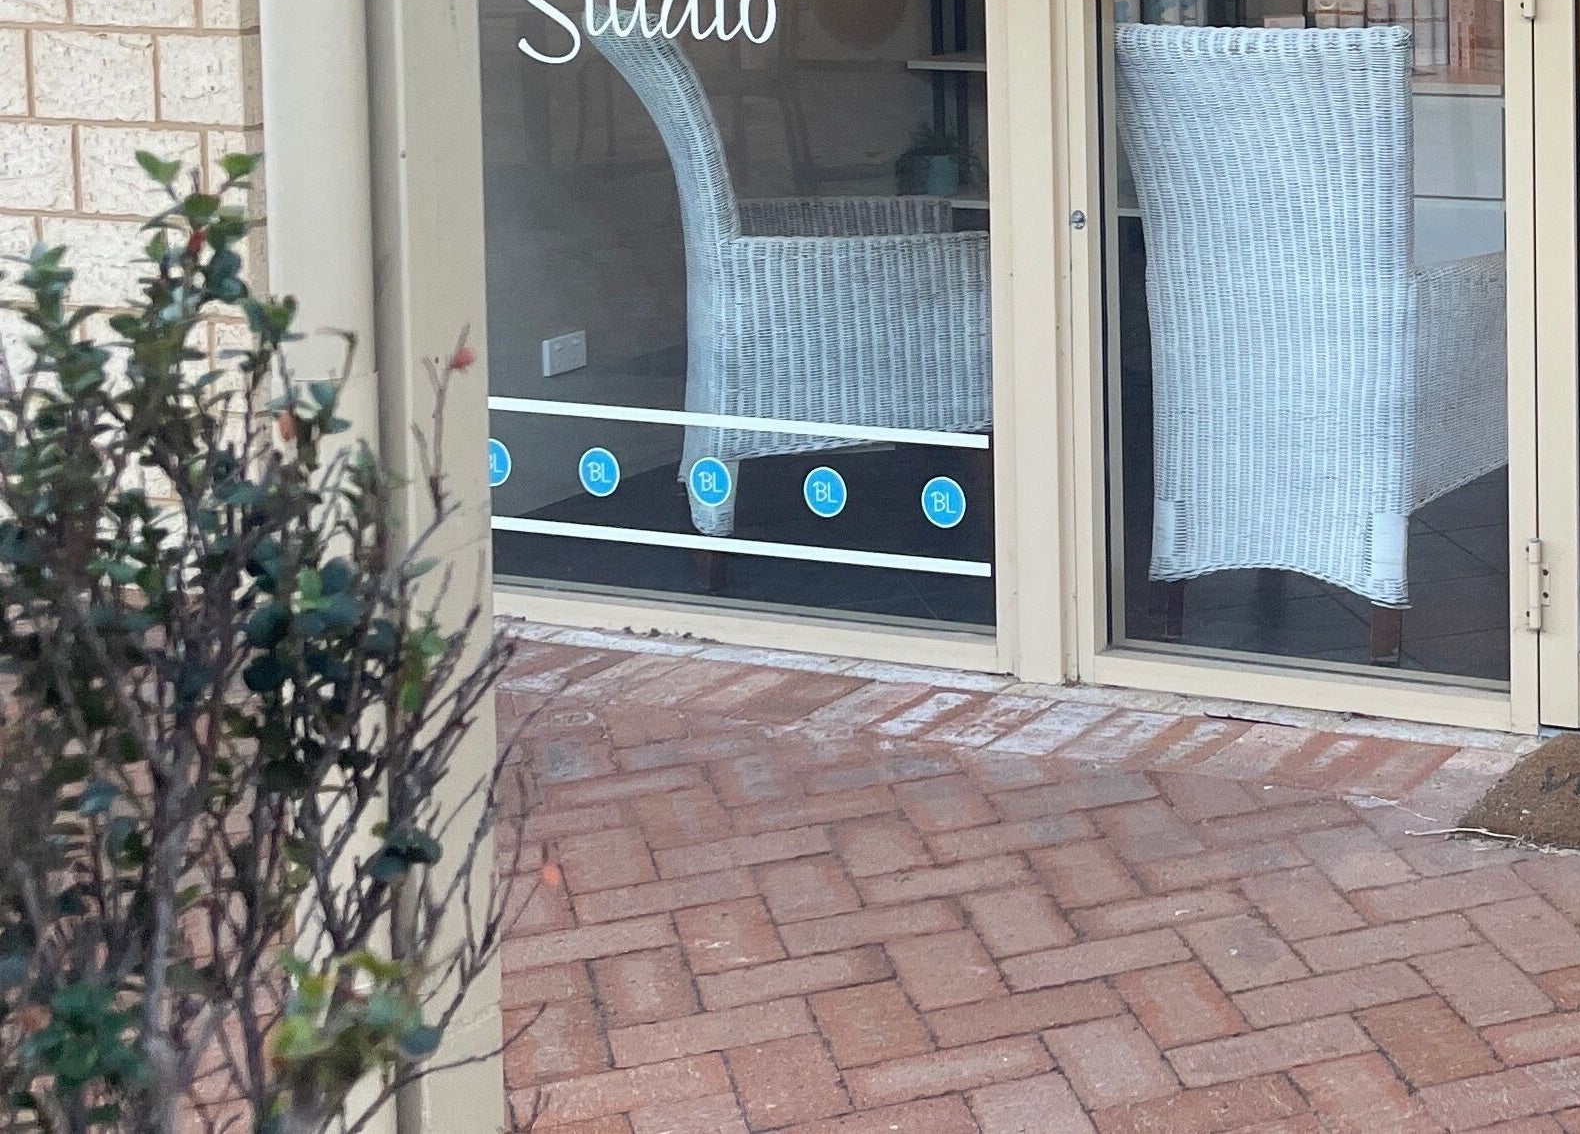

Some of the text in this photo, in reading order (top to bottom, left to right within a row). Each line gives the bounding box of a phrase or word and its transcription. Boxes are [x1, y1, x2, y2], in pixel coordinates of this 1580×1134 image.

[587, 460, 613, 484] BL
[697, 471, 725, 494] BL
[812, 480, 839, 504] BL
[930, 490, 958, 515] BL
